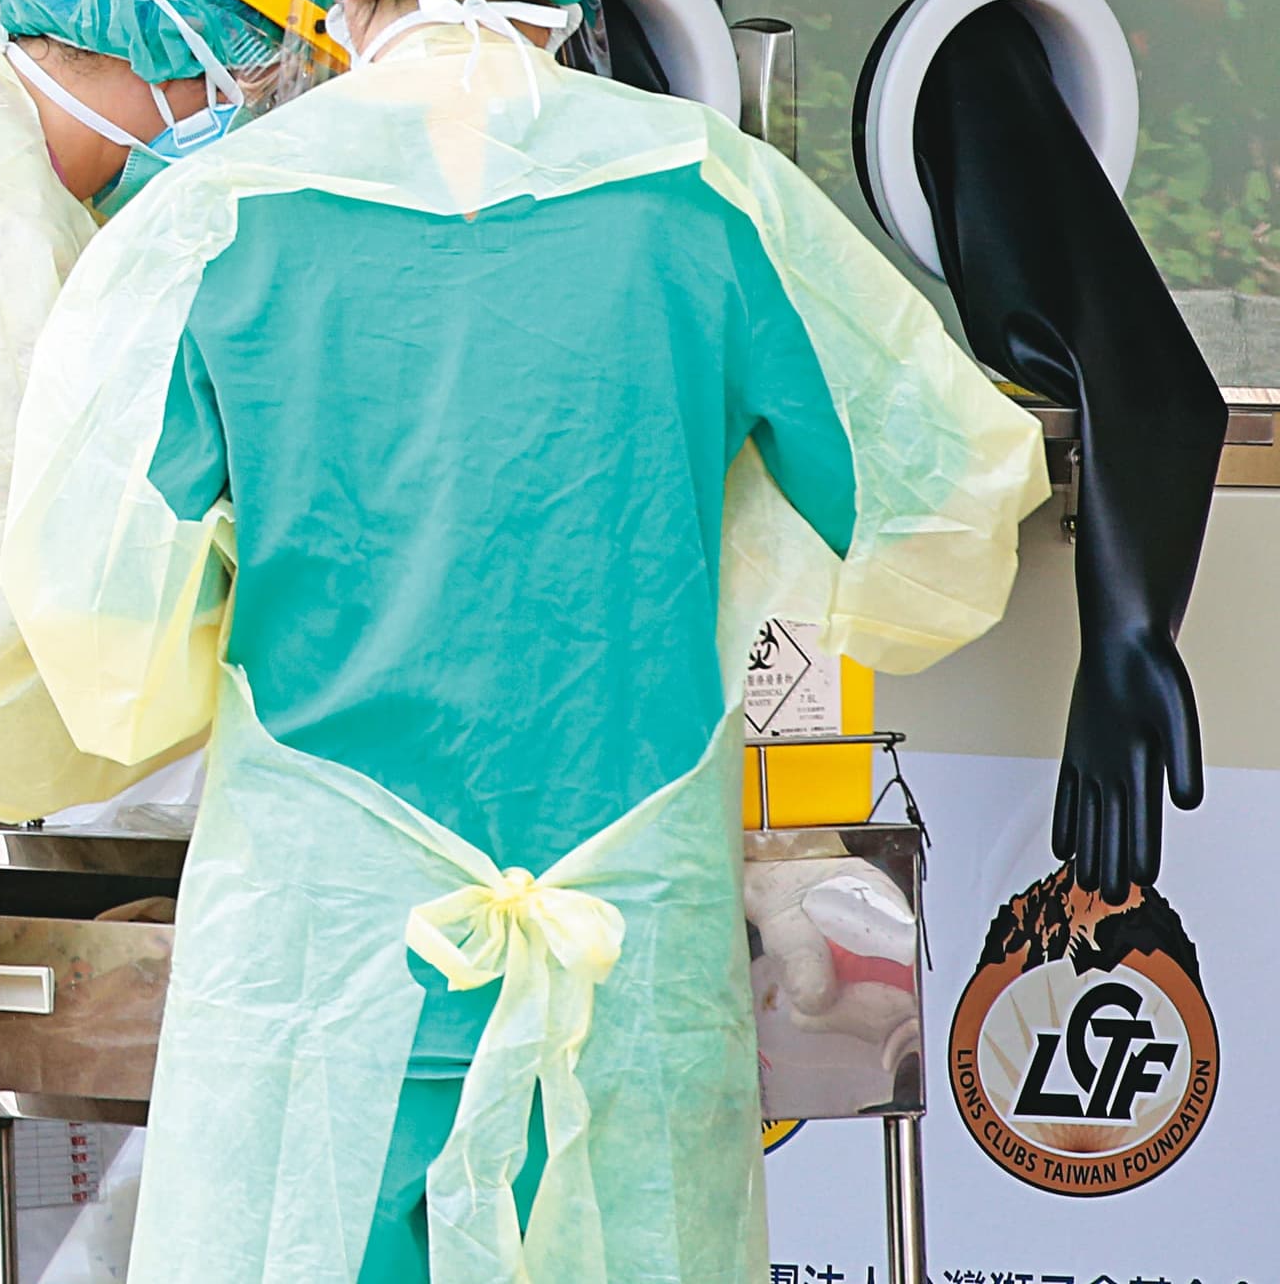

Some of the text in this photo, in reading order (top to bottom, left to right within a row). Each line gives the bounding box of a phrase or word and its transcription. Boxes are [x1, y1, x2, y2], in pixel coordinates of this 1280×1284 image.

[957, 1049, 1211, 1185] LIONS CLUBS TAIWAN FOUNDATION
